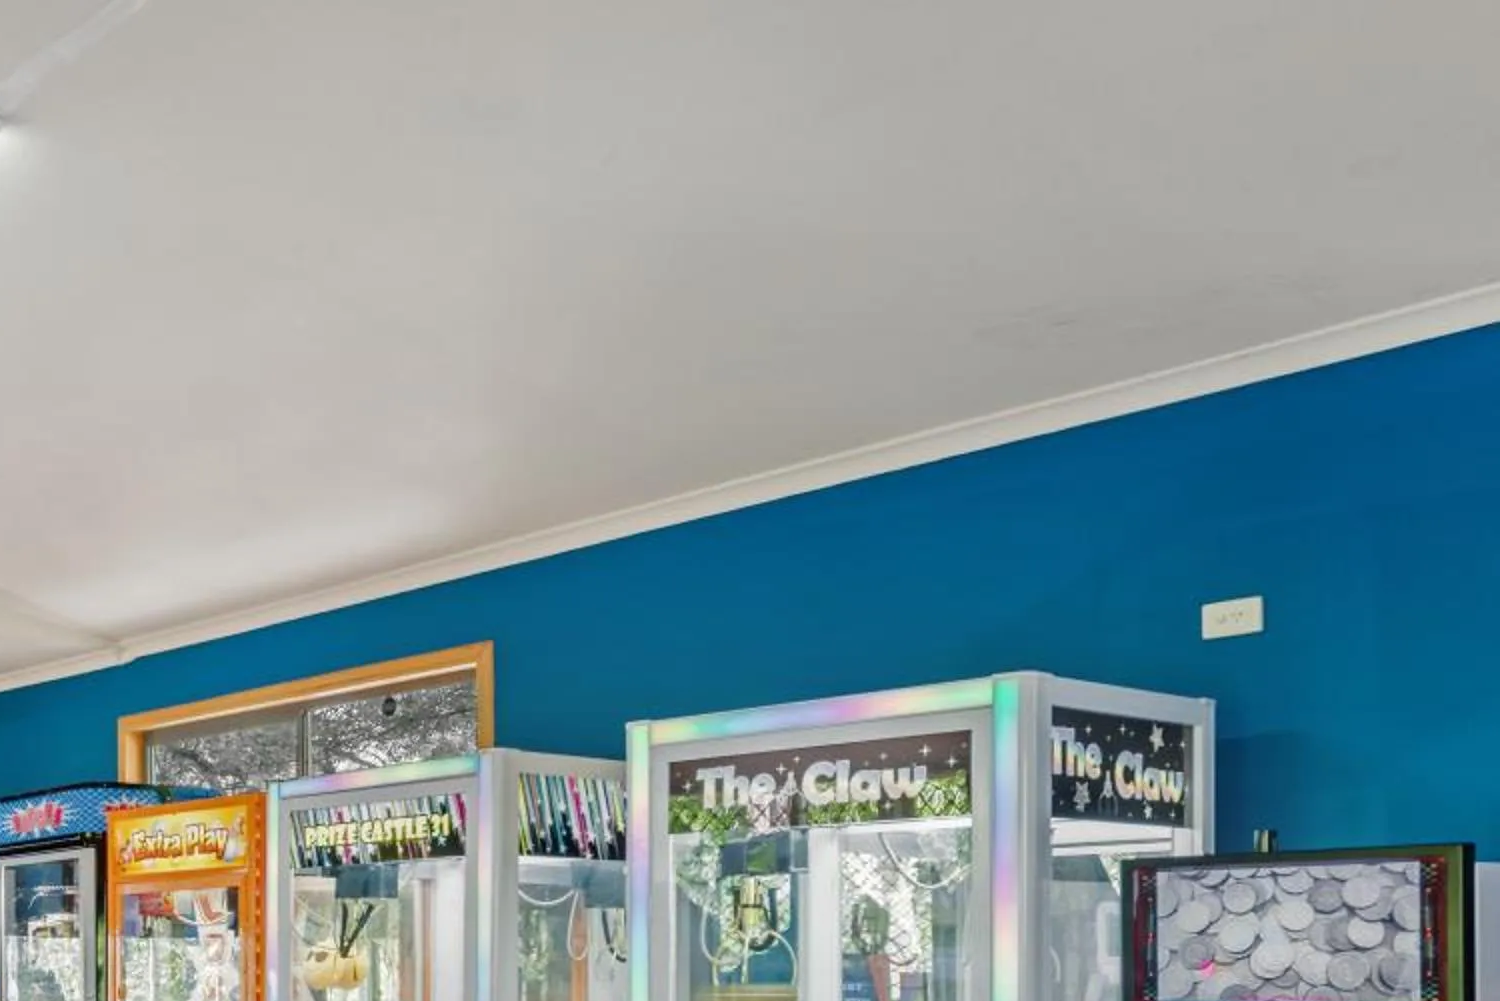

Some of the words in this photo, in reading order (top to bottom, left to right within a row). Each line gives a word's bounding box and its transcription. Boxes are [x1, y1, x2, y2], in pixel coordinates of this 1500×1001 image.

[696, 765, 777, 809] The
[802, 760, 927, 805] Claw
[1050, 725, 1102, 780] The
[1115, 750, 1184, 803] Claw
[132, 829, 182, 859] Extra
[185, 823, 229, 860] Play
[305, 823, 357, 848] PRIZE
[361, 816, 428, 843] CASTLE
